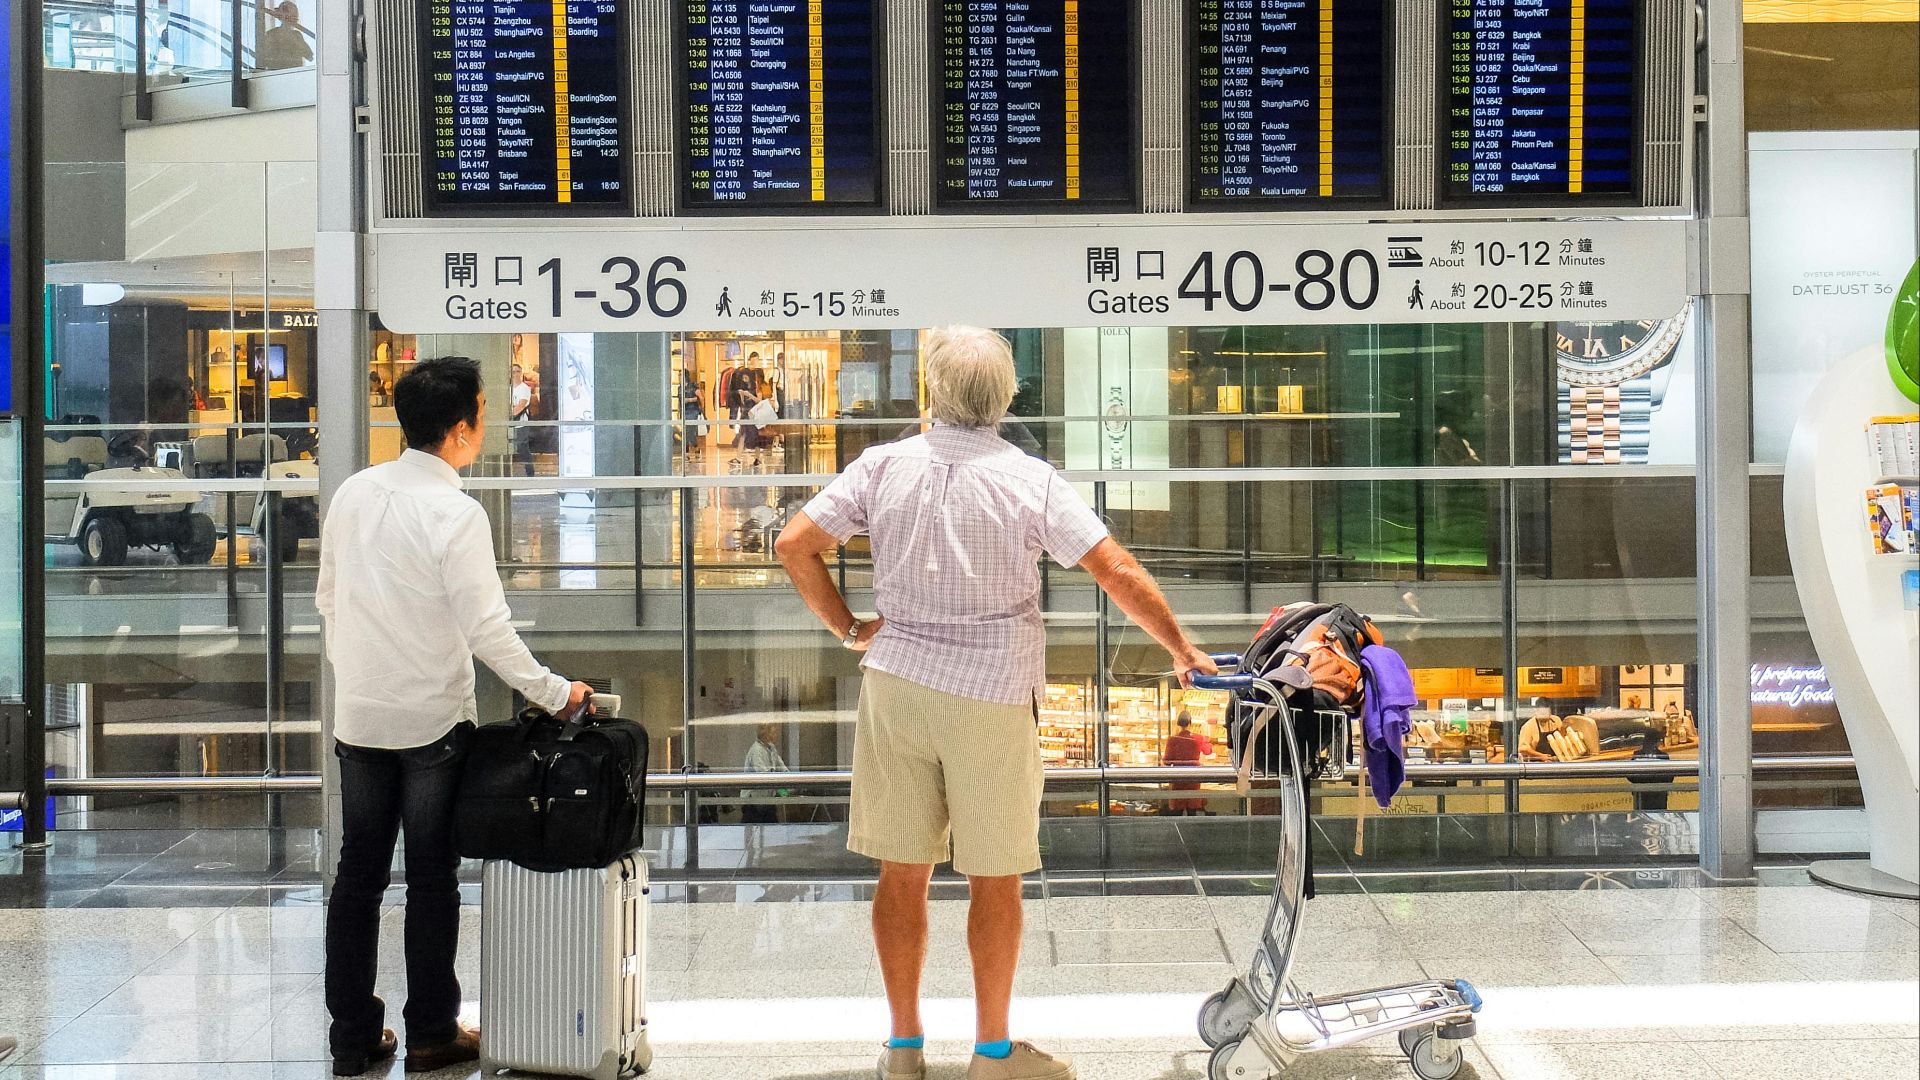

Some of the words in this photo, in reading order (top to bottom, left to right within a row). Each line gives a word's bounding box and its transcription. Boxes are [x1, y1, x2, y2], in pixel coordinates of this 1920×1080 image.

[432, 6, 450, 14] 12:50
[456, 6, 467, 14] KA
[468, 6, 484, 14] 1104
[493, 5, 516, 16] Tianjin
[567, 5, 579, 13] Est
[596, 4, 615, 13] 15:00
[688, 4, 706, 13] 13:30
[712, 4, 722, 12] AK
[724, 4, 737, 12] 135
[749, 4, 769, 12] Kuala
[771, 4, 796, 14] Lumpur
[1452, 9, 1471, 18] 15:30
[1476, 9, 1487, 18] HX
[1513, 8, 1549, 19] Tokyo/NRT
[432, 17, 450, 26] 12:50
[456, 17, 468, 26] CX
[494, 16, 531, 27] Zhengzhou
[568, 16, 598, 27] Boarding
[944, 14, 962, 22] 14:10
[968, 14, 980, 22] CX
[1006, 14, 1025, 22] Guilin
[432, 28, 451, 37] 12:50
[457, 28, 469, 36] MU
[470, 28, 483, 36] 502
[494, 28, 543, 38] Shanghai/PVG
[568, 28, 598, 38] Boarding
[688, 38, 707, 46] 13:35
[712, 38, 723, 46] 7C
[724, 38, 741, 46] 2102
[750, 37, 784, 46] Seoul/ICN
[1452, 42, 1470, 50] 15:35
[1476, 42, 1486, 50] FD
[1487, 42, 1500, 50] 521
[1512, 42, 1530, 50] Krabi
[433, 50, 452, 59] 12:55
[457, 50, 468, 59] CX
[494, 50, 508, 59] Los
[507, 50, 536, 60] Angeles
[1200, 45, 1218, 54] 15:00
[1224, 45, 1234, 53] KA
[1261, 45, 1287, 54] Penang
[945, 58, 963, 67] 14:15
[981, 58, 994, 67] 272
[1006, 58, 1040, 69] Nanchang
[1452, 53, 1470, 62] 15:35
[1512, 53, 1535, 64] Beijing
[945, 81, 964, 89] 14:20
[969, 80, 980, 88] KA
[1006, 80, 1032, 90] Yangon
[1200, 78, 1218, 87] 15:00
[1224, 78, 1235, 88] KA
[1261, 78, 1284, 88] Beijing
[1452, 75, 1470, 84] 15:40
[1476, 75, 1484, 83] 5J
[1512, 75, 1530, 83] Cebu
[690, 126, 709, 134] 13:45
[714, 126, 726, 134] UO
[752, 126, 788, 136] Tokyo/NRT
[1200, 122, 1218, 130] 15:05
[1224, 122, 1236, 130] UO
[1261, 122, 1290, 130] Fukuoka
[1475, 130, 1486, 138] BA
[1512, 130, 1536, 138] Jakarta
[946, 136, 964, 144] 14:30
[970, 135, 981, 144] CX
[1007, 135, 1041, 145] Singapore
[436, 150, 455, 158] 13:10
[460, 150, 472, 159] CX
[473, 150, 486, 158] 157
[498, 149, 528, 158] Brisbane
[571, 149, 583, 157] Est
[600, 148, 619, 157] 14:20
[691, 170, 710, 178] 14:00
[715, 170, 724, 178] CI
[752, 170, 772, 179] Taipei
[1200, 166, 1219, 174] 15:15
[1224, 166, 1233, 174] JL
[1261, 165, 1298, 175] Tokyo/HND
[1451, 173, 1469, 182] 15:55
[1474, 173, 1485, 181] CX
[1486, 173, 1498, 181] 701
[1511, 173, 1540, 183] Bangkok
[437, 183, 456, 191] 13:10
[462, 182, 472, 191] EY
[499, 182, 513, 190] San
[514, 182, 546, 190] Francisco
[572, 182, 584, 190] Est
[601, 181, 620, 190] 18:00
[1451, 240, 1464, 254] 約
[1560, 238, 1593, 256] 分鐘
[1429, 257, 1464, 267] About
[1475, 241, 1550, 266] 10-12
[1559, 255, 1605, 265] Minutes
[1087, 247, 1164, 283] 閘口
[445, 253, 522, 289] 閘口
[1088, 290, 1169, 314] Gates
[1178, 249, 1379, 312] 40-80
[446, 295, 527, 319] Gates
[538, 256, 687, 318] 1-36
[1451, 282, 1465, 297] 約
[1560, 281, 1594, 299] 分鐘
[1793, 284, 1869, 295] DATEJUST
[1874, 284, 1893, 294] 36
[761, 290, 774, 305] 約
[852, 289, 885, 304] 分鐘
[1430, 300, 1466, 310] About
[1474, 284, 1553, 308] 20-25
[1561, 296, 1607, 308] Minutes
[739, 307, 775, 317] About
[783, 292, 845, 317] 5-15
[853, 306, 899, 316] Minutes
